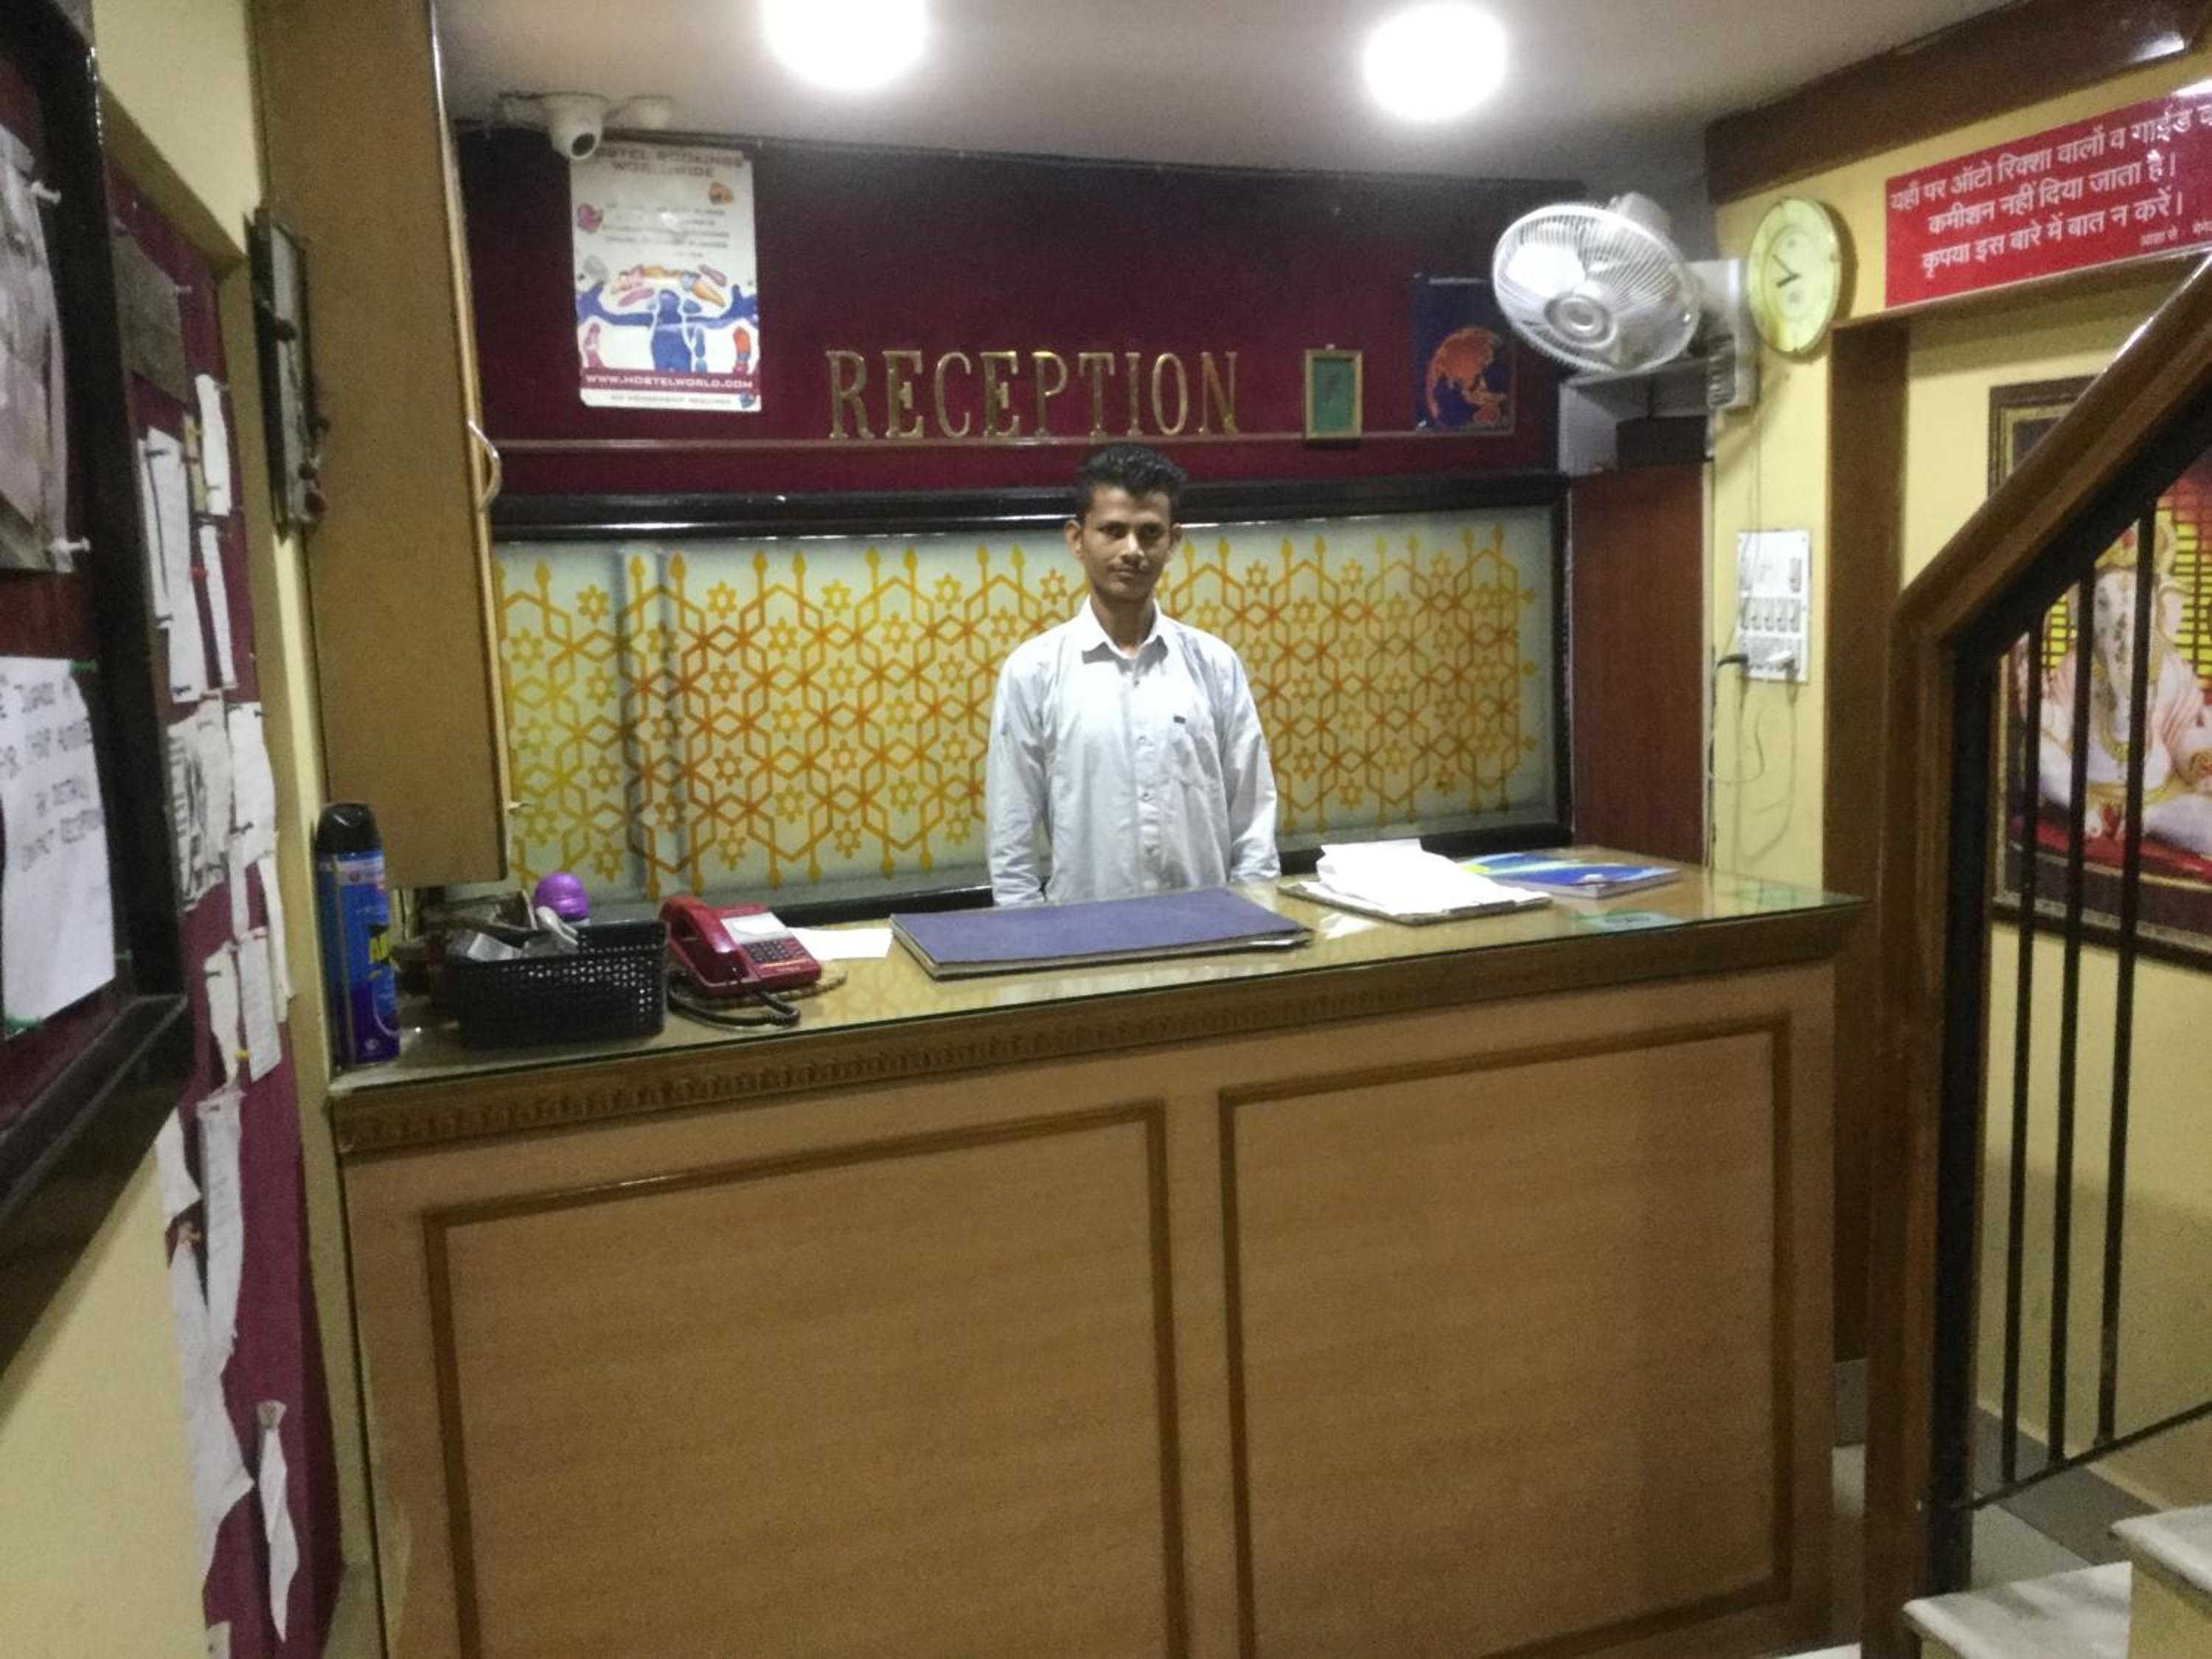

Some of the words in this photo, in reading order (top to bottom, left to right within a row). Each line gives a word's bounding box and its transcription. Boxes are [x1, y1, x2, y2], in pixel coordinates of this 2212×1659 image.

[1924, 179, 1947, 201] पर
[1950, 159, 1992, 194] ऑटो
[1997, 153, 2053, 183] रिक्शा
[2056, 125, 2105, 164] वालों
[2110, 127, 2126, 150] व
[1927, 201, 1995, 234] कमीशन
[1999, 181, 2037, 215] नहीं
[2039, 177, 2084, 207] दिया
[2088, 161, 2142, 192] जाता
[1921, 243, 1971, 278] कृपया
[1975, 234, 2006, 262] इस
[2010, 219, 2042, 250] बारे
[2046, 212, 2064, 241] में
[2066, 211, 2105, 237] बात
[2110, 205, 2129, 227] न
[825, 349, 1238, 439] RECEPTION
